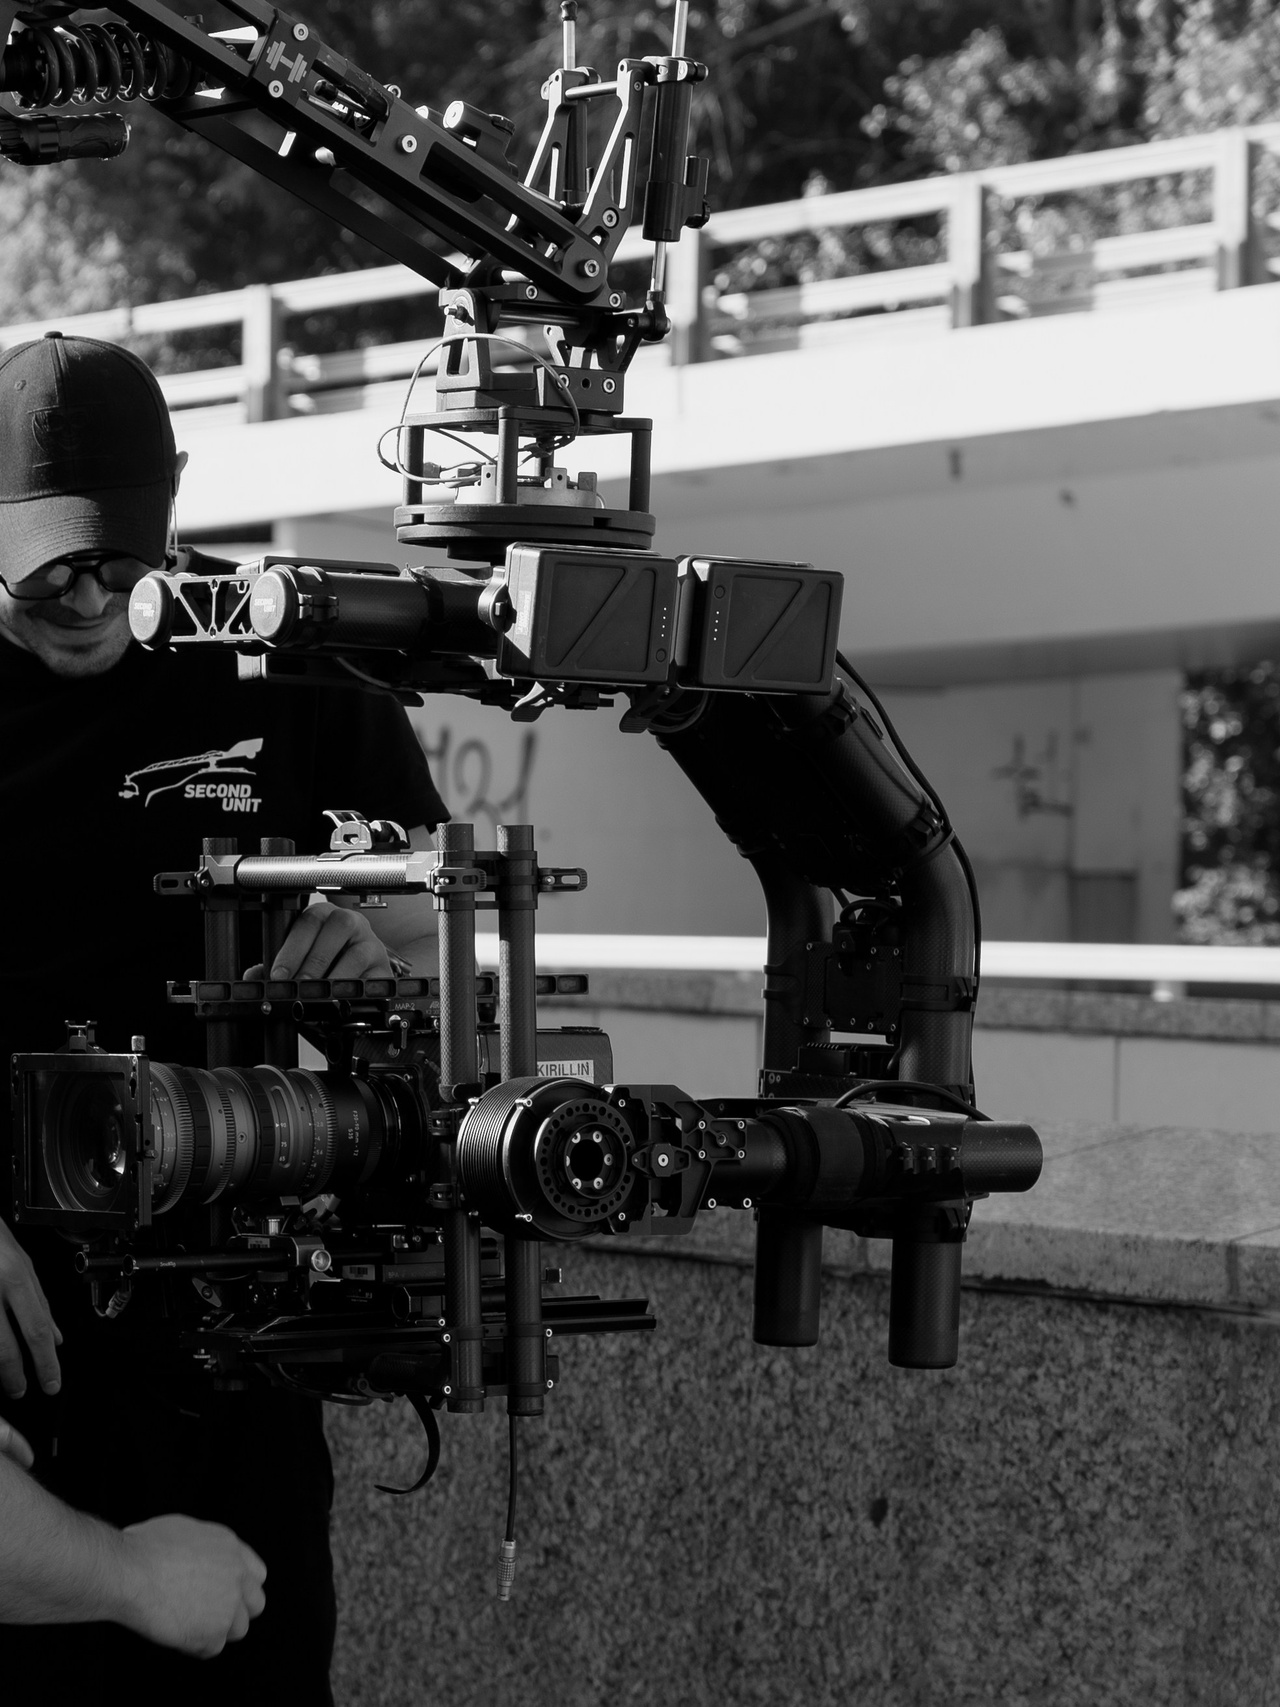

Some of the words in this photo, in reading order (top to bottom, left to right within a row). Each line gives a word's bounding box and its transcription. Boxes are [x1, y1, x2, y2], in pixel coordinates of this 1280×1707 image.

[183, 783, 252, 798] SECOND
[222, 797, 262, 813] UNIT
[395, 1002, 416, 1011] MAP-2
[537, 1062, 590, 1077] KIRILLIN
